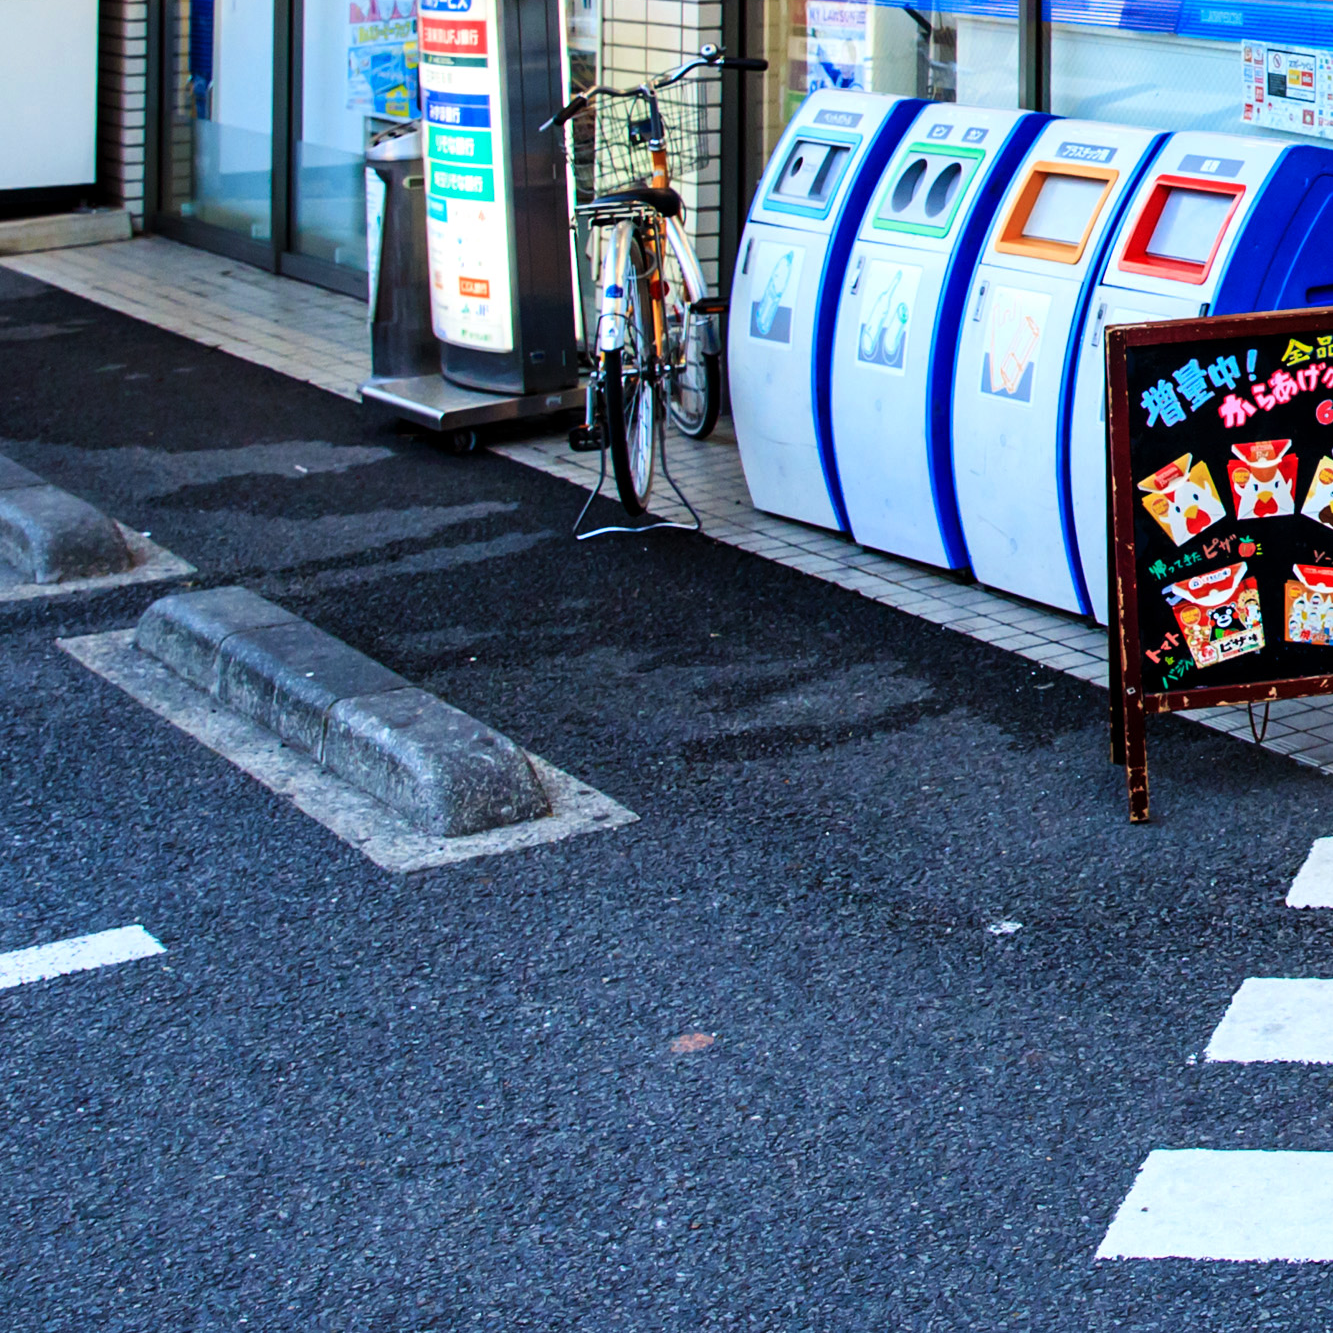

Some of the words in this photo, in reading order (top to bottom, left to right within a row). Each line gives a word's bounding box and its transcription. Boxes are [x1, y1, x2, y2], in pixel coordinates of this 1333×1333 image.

[435, 135, 475, 158] りそな銀行
[1141, 349, 1260, 429] 増量中!
[1202, 533, 1238, 560] ピザ
[1145, 630, 1180, 664] トマト
